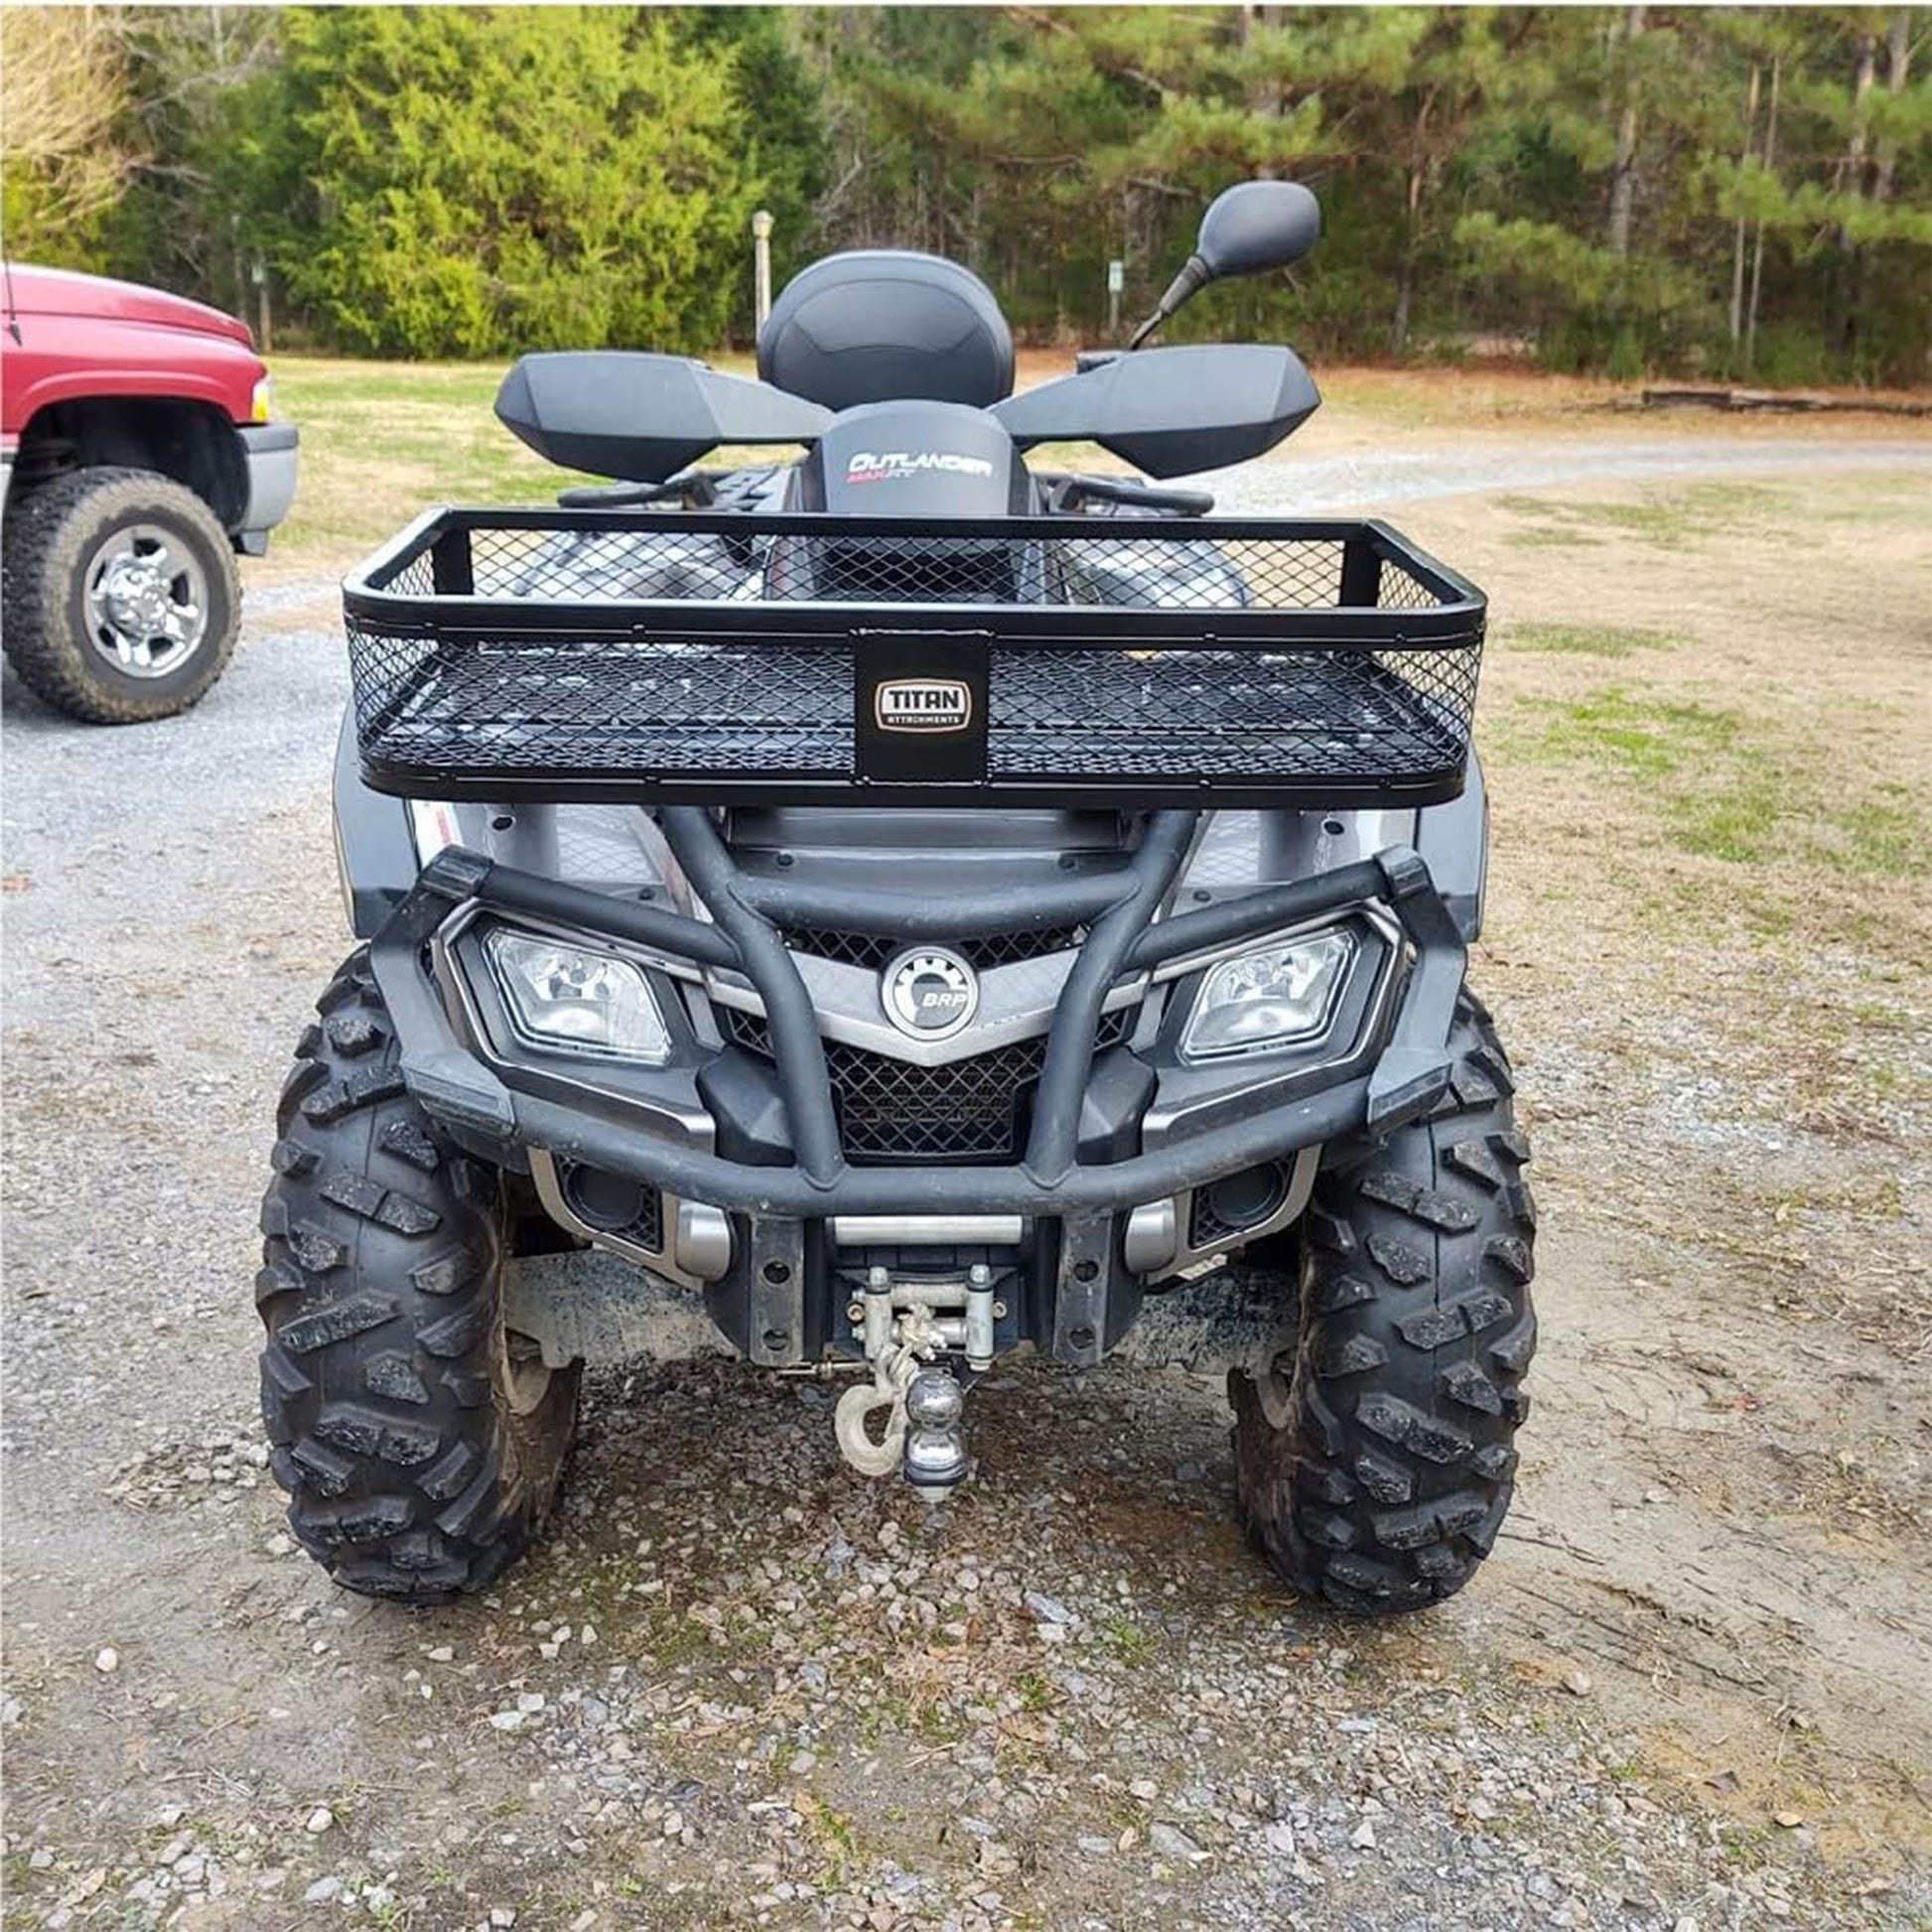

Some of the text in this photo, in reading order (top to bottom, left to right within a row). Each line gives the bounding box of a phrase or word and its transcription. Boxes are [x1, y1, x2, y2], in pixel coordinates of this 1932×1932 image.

[849, 453, 993, 477] OUTLANDER
[889, 690, 959, 709] TITAN
[922, 993, 967, 1008] BRP
